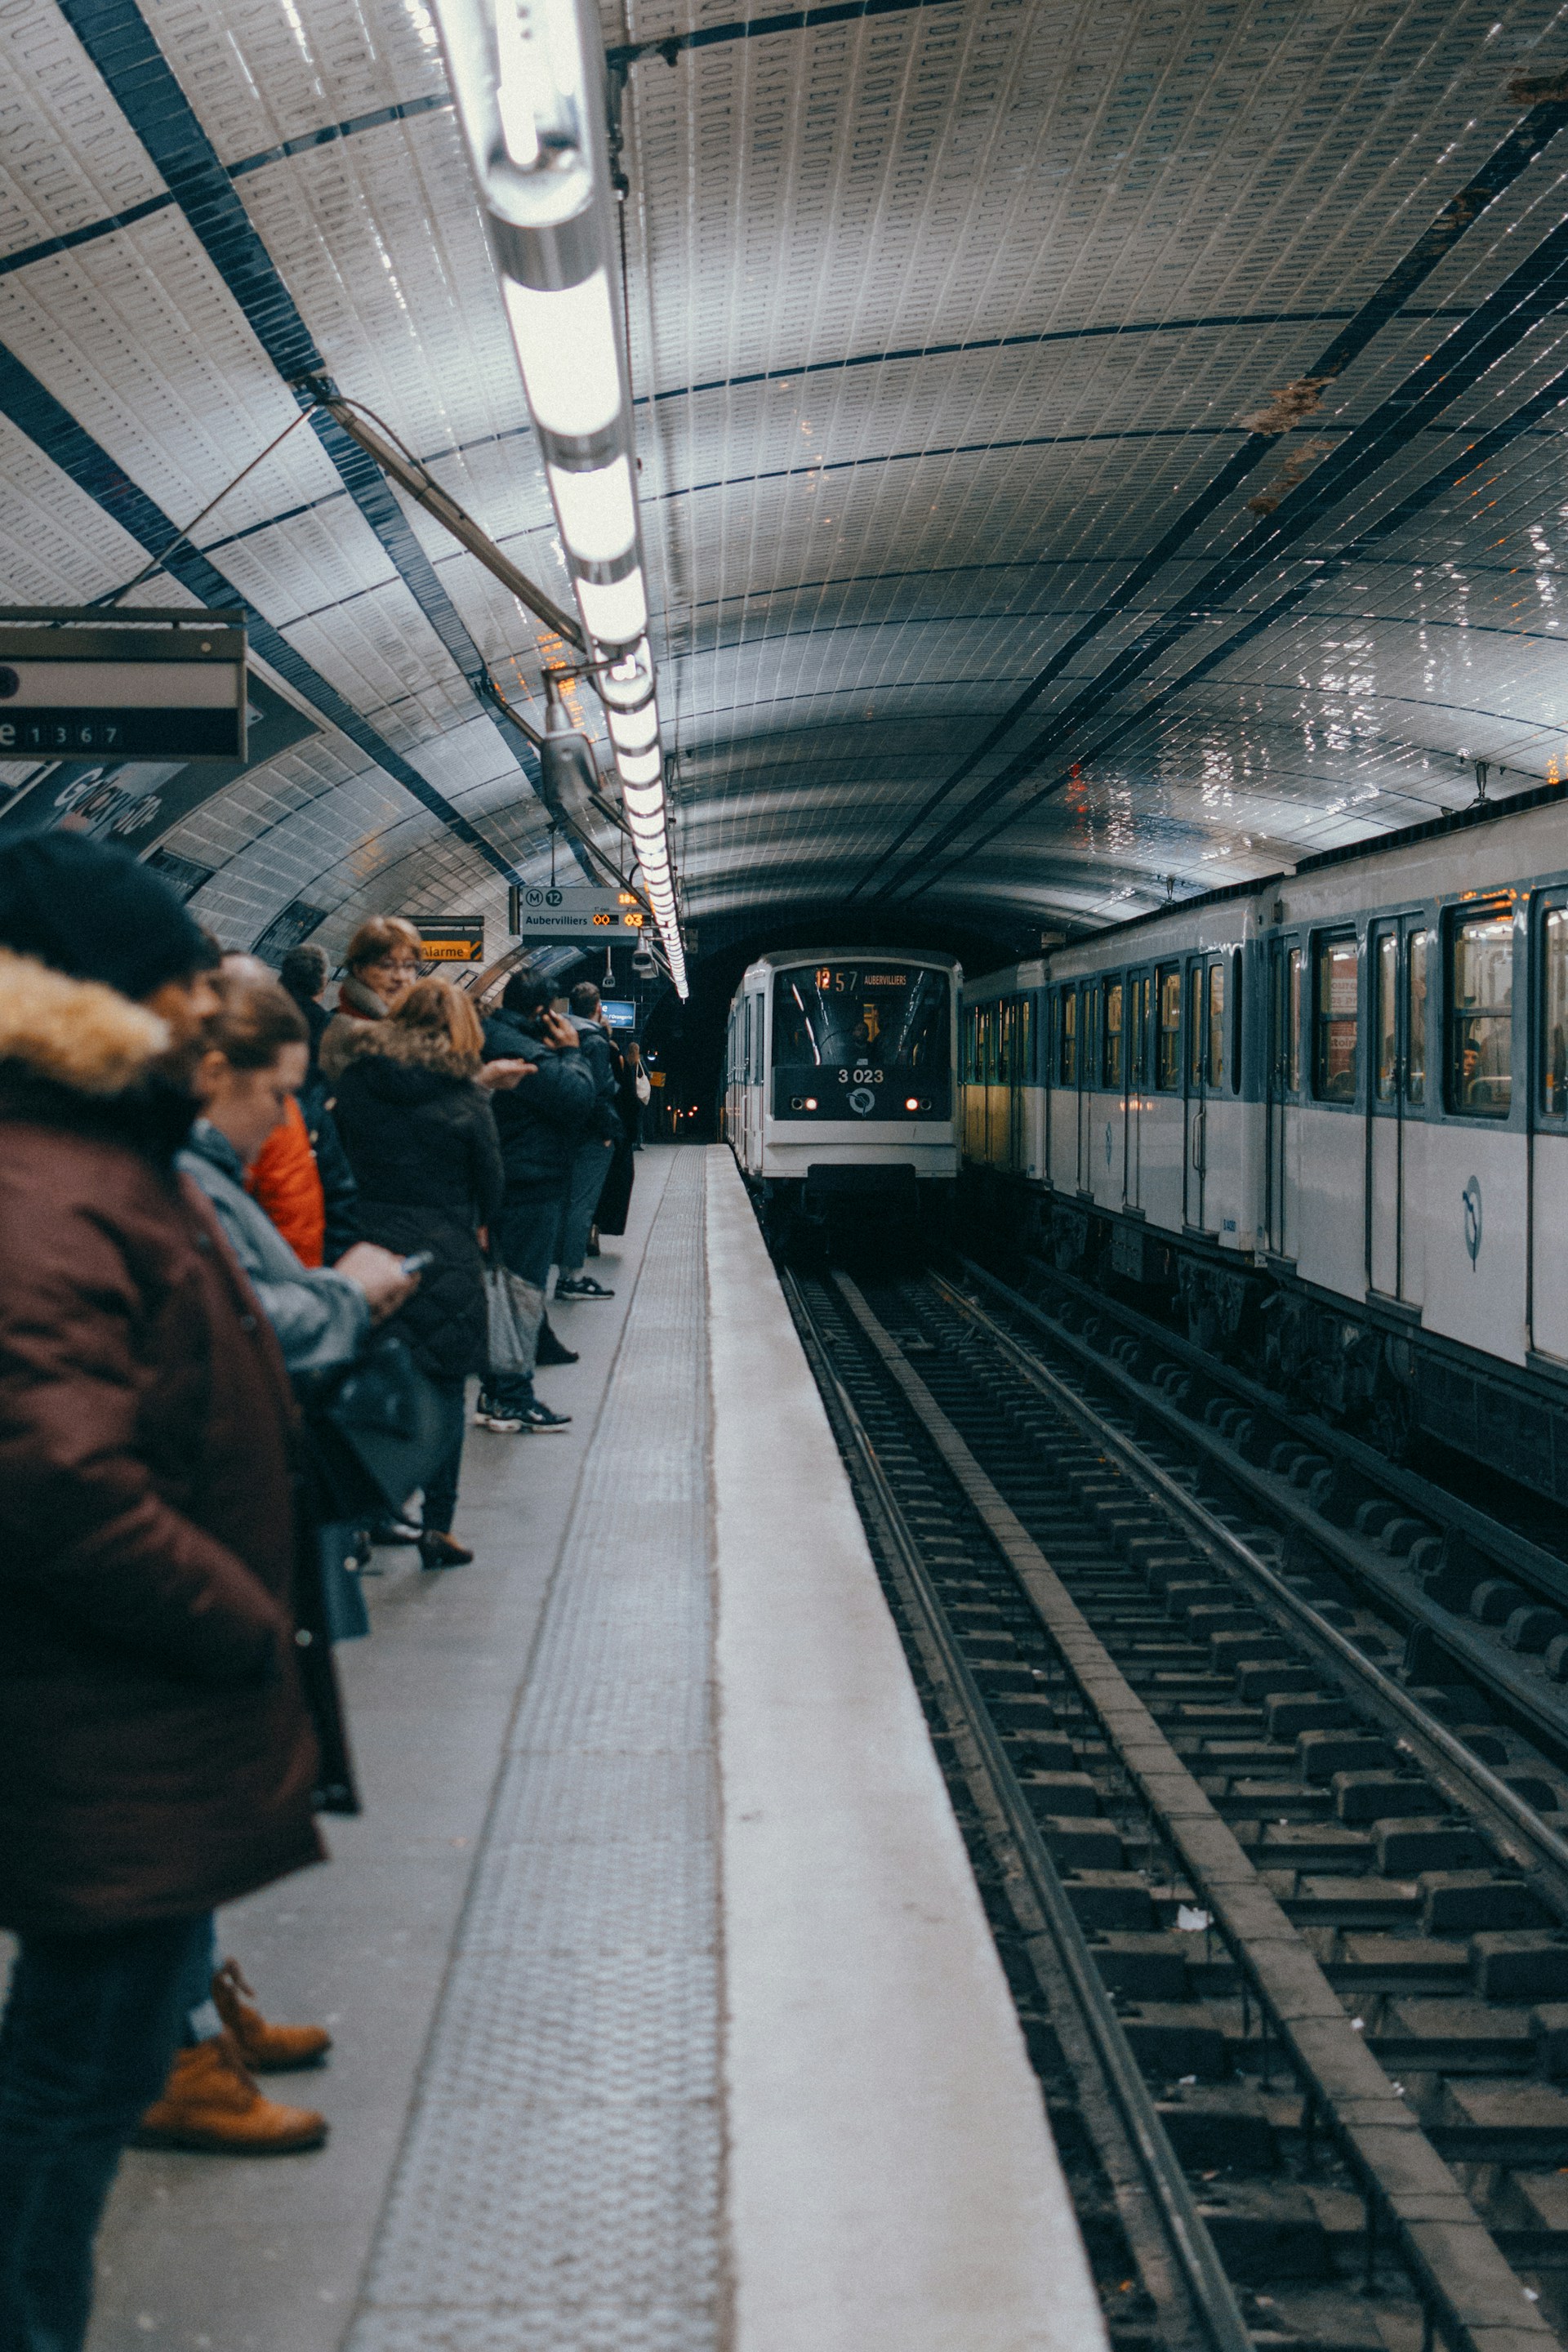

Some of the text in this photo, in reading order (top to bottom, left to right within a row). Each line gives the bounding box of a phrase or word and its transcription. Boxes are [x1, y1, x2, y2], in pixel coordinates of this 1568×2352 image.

[32, 727, 39, 743] 1
[56, 727, 67, 743] 3
[81, 727, 92, 743] 6
[106, 727, 117, 743] 7
[525, 915, 588, 925] Aubervilliers
[593, 914, 610, 925] 00
[624, 913, 643, 927] 03
[864, 975, 906, 985] AUBERVILLIERS
